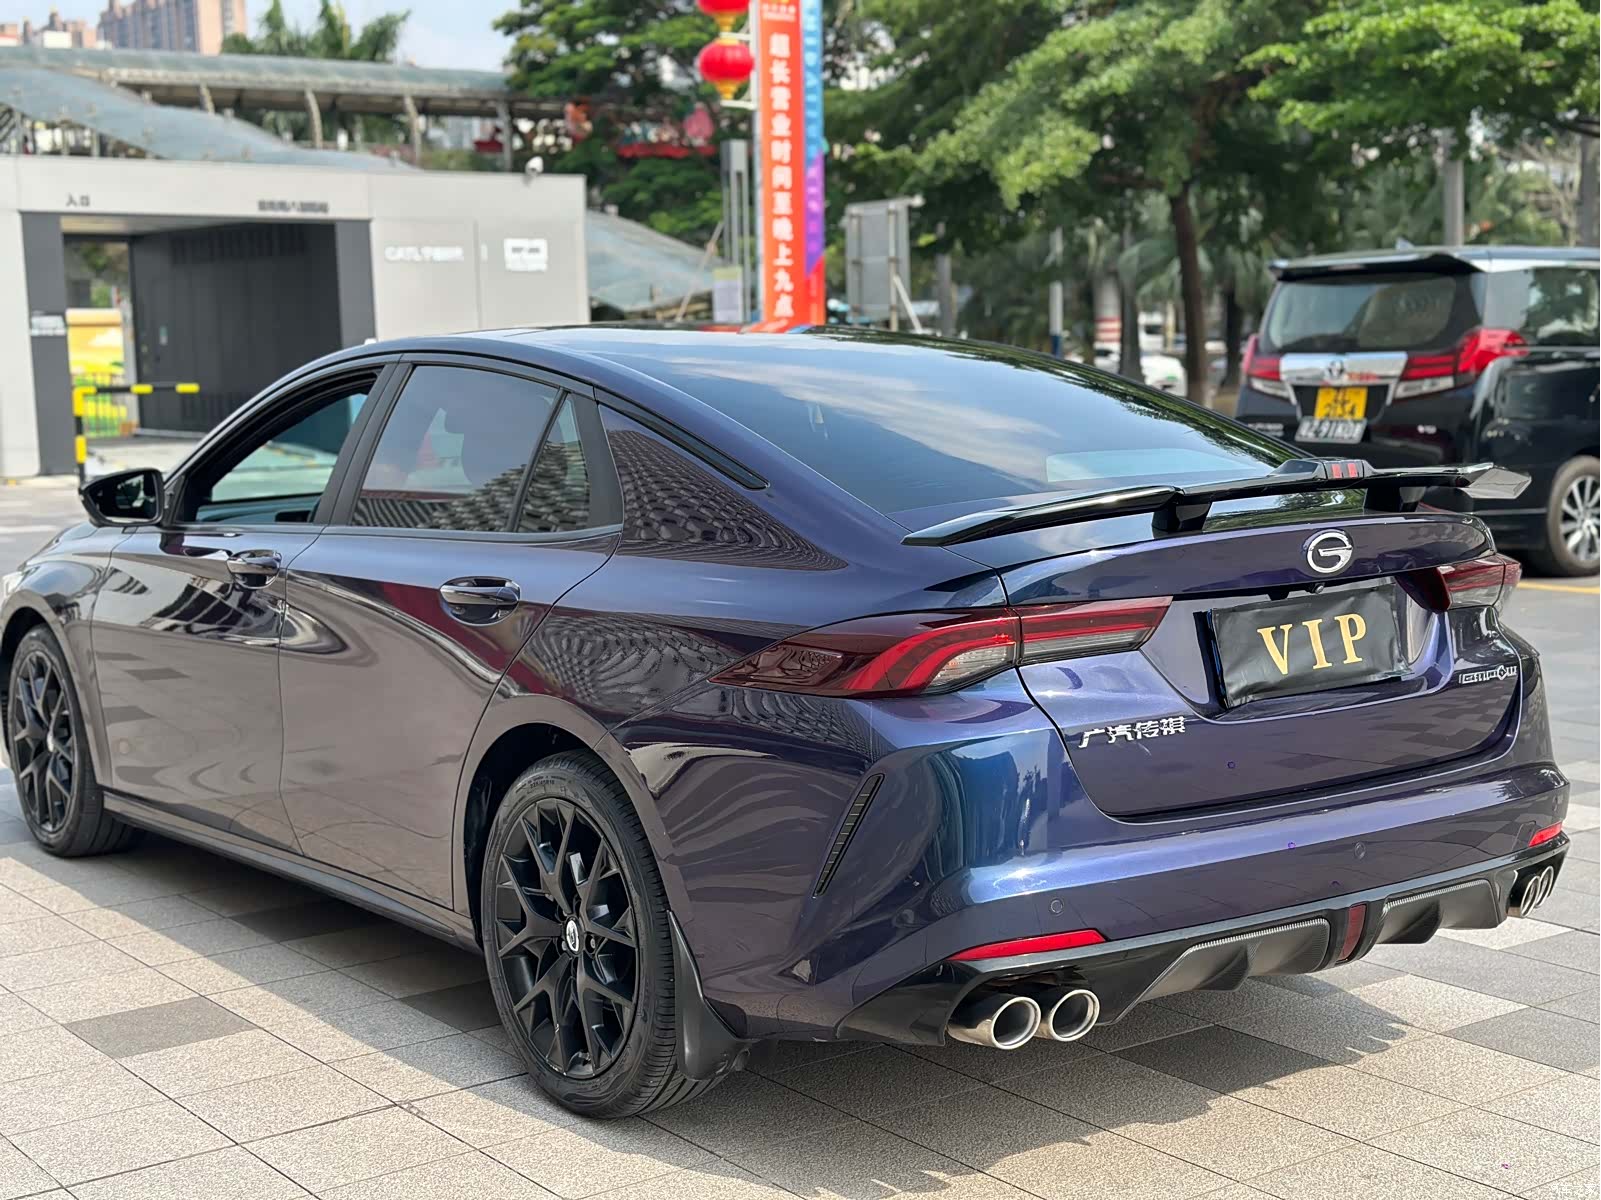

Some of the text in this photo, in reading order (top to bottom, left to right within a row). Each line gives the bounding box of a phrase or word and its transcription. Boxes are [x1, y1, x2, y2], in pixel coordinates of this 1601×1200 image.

[65, 194, 91, 207] 入口
[1257, 612, 1367, 676] VIP
[1078, 716, 1186, 748] 广汽传祺
